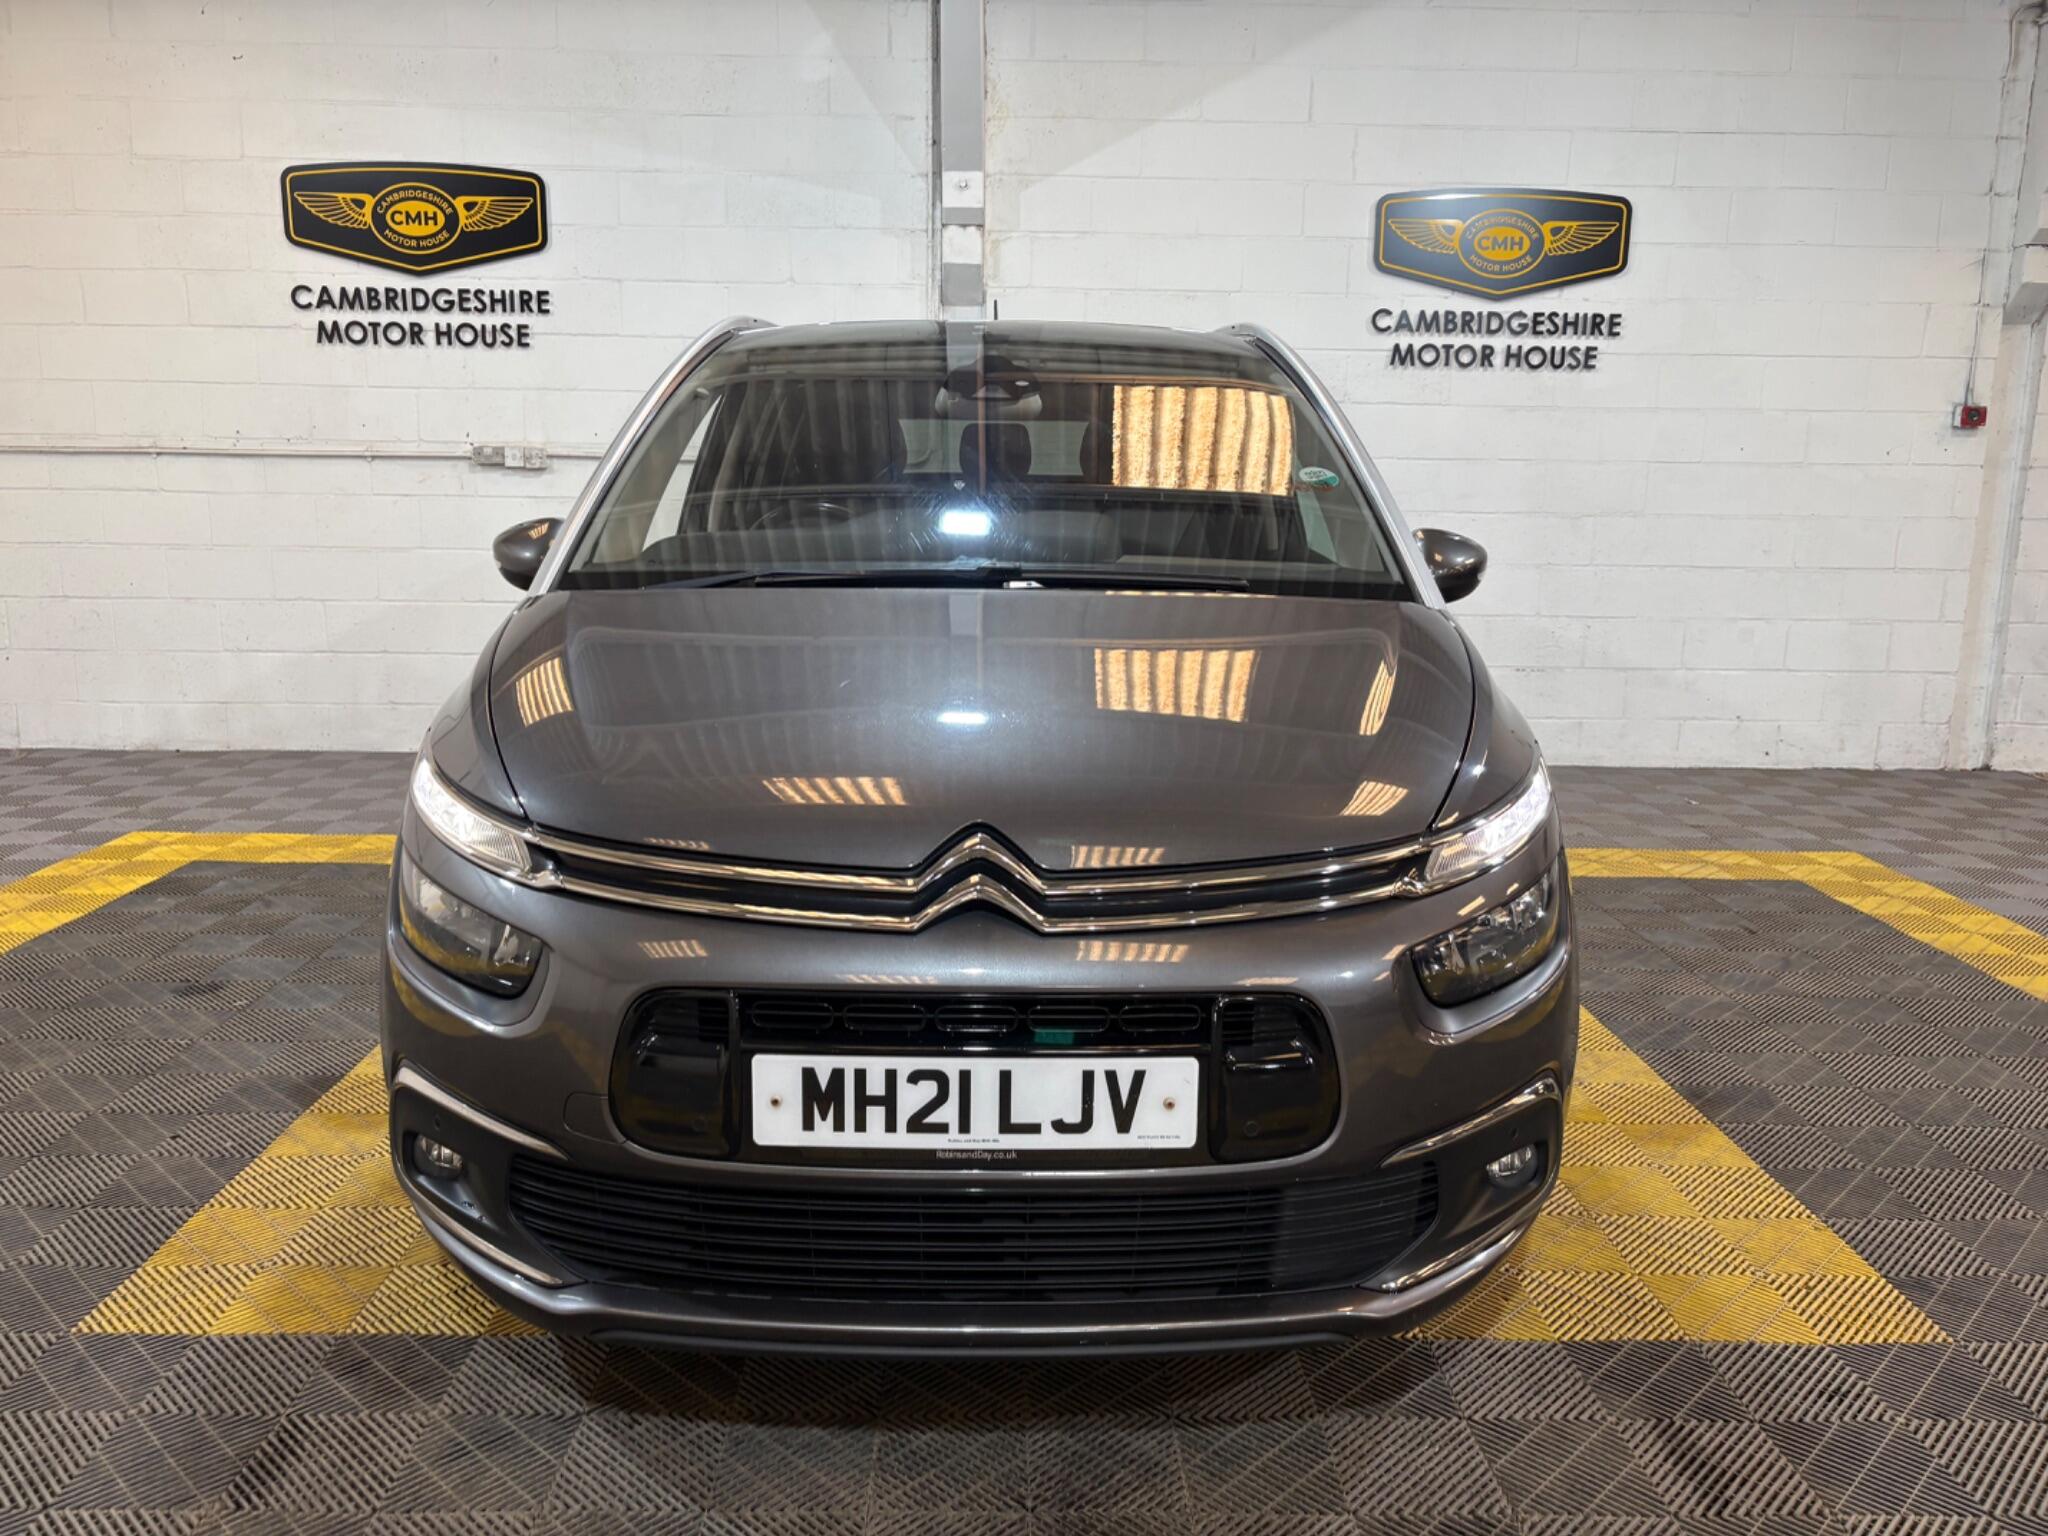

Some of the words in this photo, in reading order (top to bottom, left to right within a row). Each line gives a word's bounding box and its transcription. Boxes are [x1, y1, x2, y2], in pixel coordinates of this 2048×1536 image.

[376, 189, 454, 215] CAMBRIDGESHIRE
[390, 210, 438, 226] CMH
[384, 229, 417, 247] MOTOR
[420, 229, 450, 247] HOUSE
[1478, 236, 1524, 251] CMH
[1470, 255, 1500, 272] MOTOR
[1502, 255, 1532, 272] HOUSE
[291, 284, 551, 314] CAMBRIDGESHIRE
[316, 320, 424, 346] MOTOR
[435, 322, 531, 348] HOUSE
[1371, 308, 1622, 337] CAMBRIDGESHIRE
[1390, 343, 1494, 368] MOTOR
[1504, 345, 1599, 370] HOUSE
[801, 1066, 971, 1135] MH21
[999, 1068, 1147, 1135] LJV
